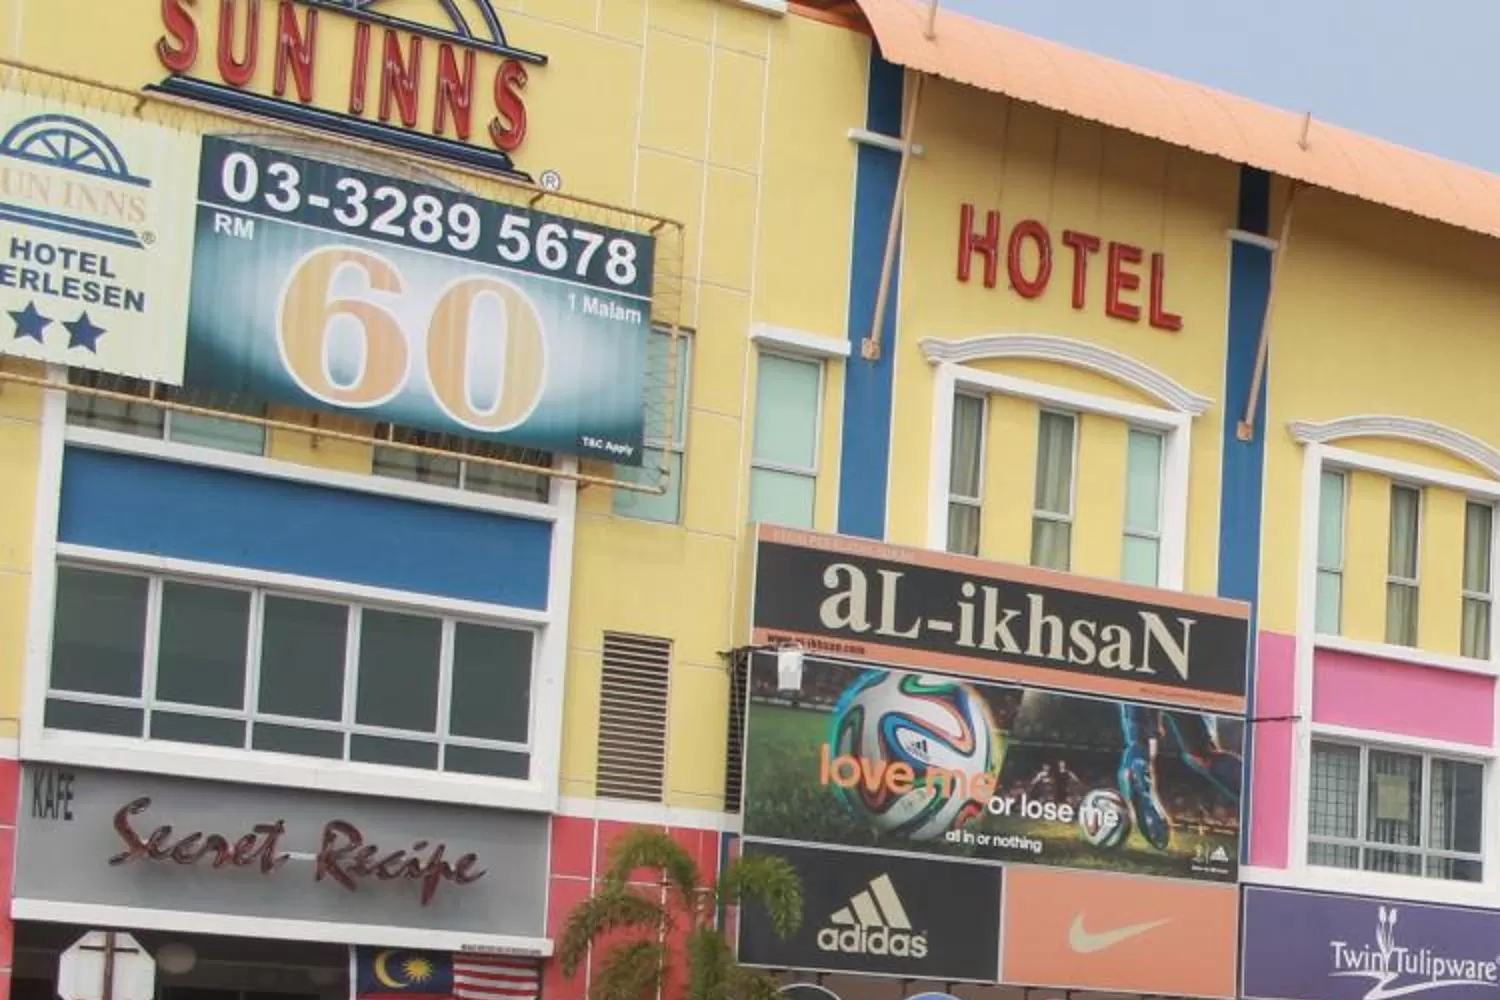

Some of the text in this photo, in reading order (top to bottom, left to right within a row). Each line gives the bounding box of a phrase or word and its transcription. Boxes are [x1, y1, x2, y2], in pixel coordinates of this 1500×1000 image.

[157, 0, 529, 152] SUN INNS
[63, 180, 147, 225] INNS
[214, 213, 254, 240] RM
[221, 152, 638, 286] 03-3289 5678
[9, 237, 116, 279] HOTEL
[957, 202, 1183, 331] HOTEL
[583, 294, 642, 325] Malam
[275, 244, 547, 433] 60
[819, 561, 1196, 681] aL-ikhsaN
[31, 768, 76, 821] KAFE
[820, 743, 997, 805] love me
[987, 792, 1119, 829] or lose me
[109, 797, 487, 906] Secret Recipe
[962, 831, 975, 845] in
[977, 834, 992, 847] or
[993, 836, 1043, 854] nothing
[817, 924, 929, 958] adidas
[1329, 940, 1498, 983] Twin Tulipware
